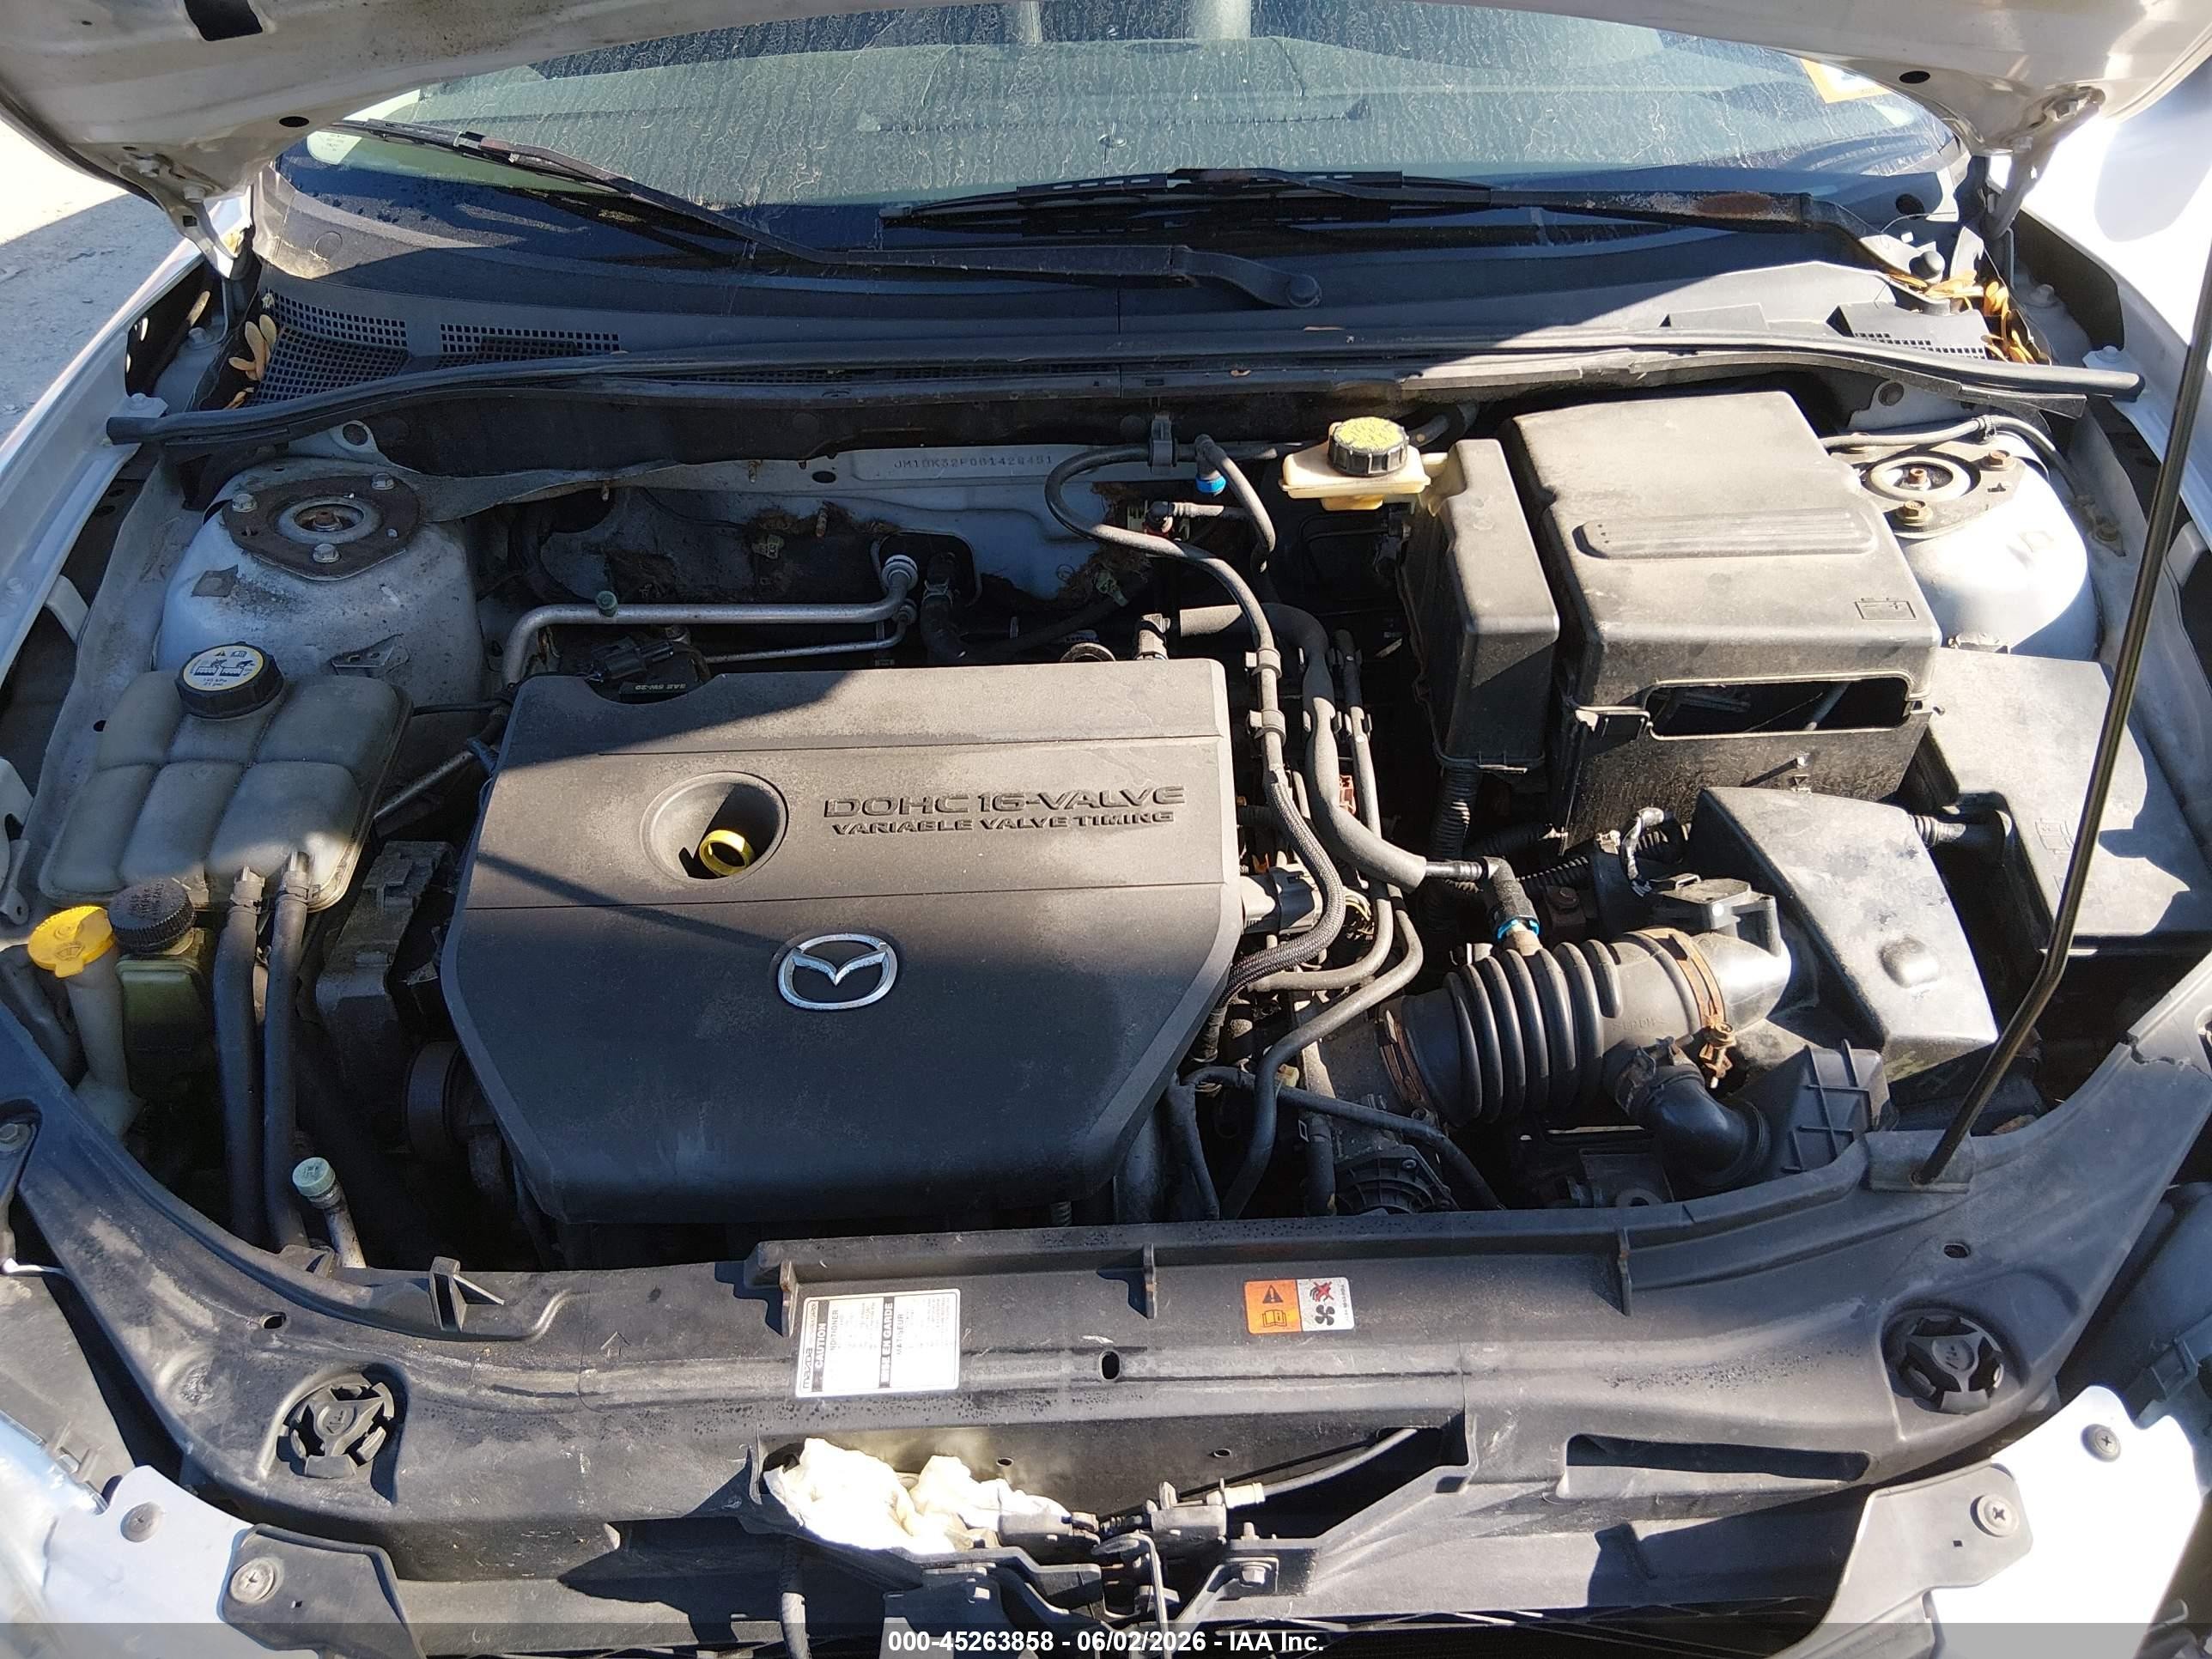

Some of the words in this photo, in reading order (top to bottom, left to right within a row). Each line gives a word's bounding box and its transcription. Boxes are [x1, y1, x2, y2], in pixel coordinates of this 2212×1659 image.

[823, 794, 969, 818] DOHC
[978, 785, 1186, 812] 16-VALVE
[831, 818, 974, 836] VARIABLE
[979, 815, 1070, 831] VALVE
[1071, 811, 1176, 828] TIMING
[883, 1302, 894, 1339] GARDE
[814, 1322, 827, 1370] CAUTION
[882, 1340, 892, 1356] EN
